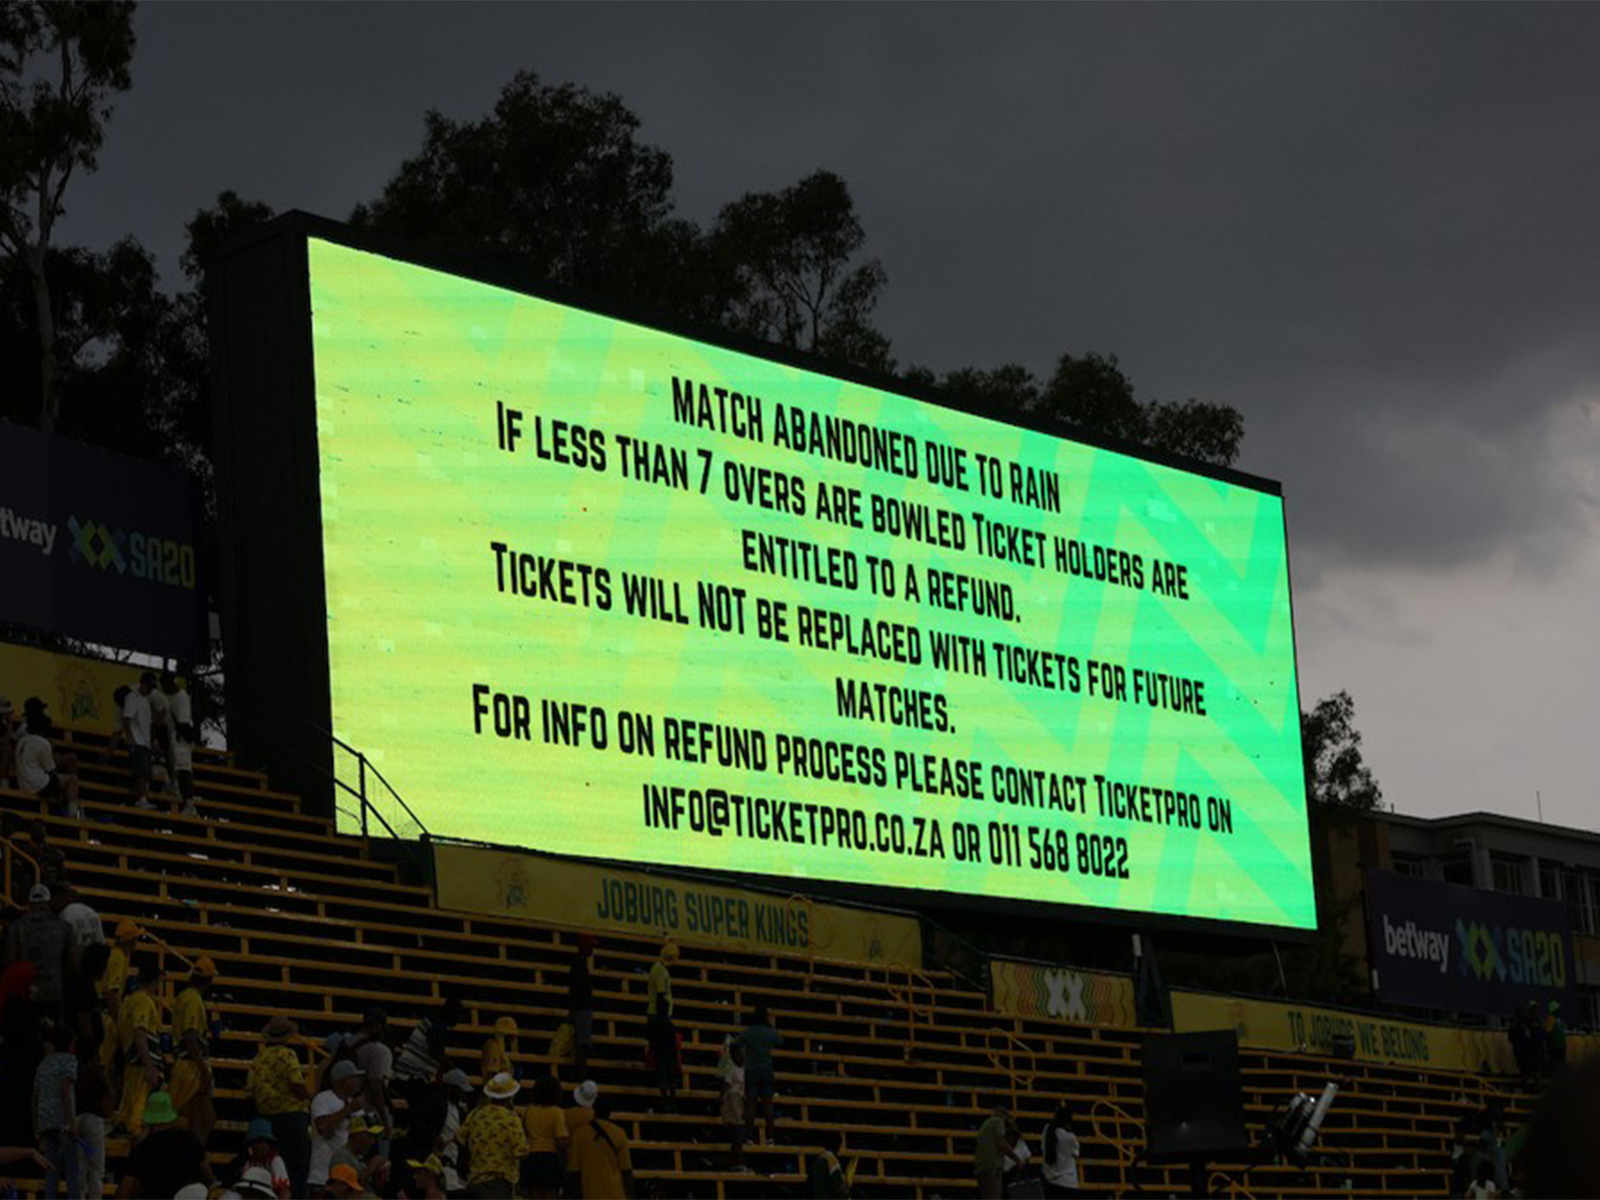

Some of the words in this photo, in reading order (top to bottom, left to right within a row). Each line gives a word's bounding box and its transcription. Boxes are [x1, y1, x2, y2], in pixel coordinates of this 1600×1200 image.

[672, 377, 763, 442] MATCH
[774, 403, 918, 478] ABANDONED
[926, 441, 968, 491] DUE
[976, 454, 1002, 499] TO
[1010, 462, 1060, 513] RAIN
[497, 401, 522, 452] IF
[536, 412, 606, 471] LESS
[616, 435, 688, 490] THAN
[698, 449, 712, 494] 7
[724, 461, 805, 515] OVERS
[816, 482, 863, 528] ARE
[871, 494, 965, 550] BOWLED
[973, 512, 1046, 568] TICKET
[1055, 536, 1144, 589] HOLDERS
[1153, 560, 1188, 600] ARE
[129, 531, 197, 589] SA20
[742, 530, 858, 590] ENTITLED
[866, 556, 895, 597] TO
[905, 564, 920, 602] A
[928, 569, 1020, 622] REFUND.
[491, 542, 611, 610] TICKETS
[622, 572, 688, 624] WILL
[698, 581, 746, 634] NOT
[757, 599, 789, 642] BE
[798, 606, 921, 665] REPLACED
[930, 631, 986, 676] WITH
[993, 643, 1080, 693] TICKETS
[1088, 660, 1126, 701] FOR
[1133, 669, 1206, 715] FUTURE
[836, 678, 955, 733] MATCHES.
[473, 684, 530, 740] FOR
[542, 698, 607, 749] INFO
[618, 711, 654, 756] ON
[664, 718, 767, 771] REFUND
[776, 734, 887, 788] PROCESS
[895, 751, 984, 800] PLEASE
[992, 765, 1086, 813] CONTACT
[1094, 775, 1201, 829] TICKETPRO
[1208, 797, 1232, 833] ON
[643, 784, 944, 858] INFO@TICKETPRO.CO.ZA
[953, 822, 980, 862] OR
[989, 822, 1021, 867] 011
[1028, 827, 1069, 872] 568
[1076, 833, 1129, 878] 8022
[597, 879, 678, 929] JOBURG
[684, 891, 749, 940] SUPER
[755, 902, 808, 948] KINGS
[1383, 914, 1450, 973] betway
[1506, 928, 1566, 988] SA20
[1287, 1011, 1304, 1046] TO
[1360, 1023, 1379, 1054] WE
[1381, 1025, 1430, 1061] BELONG
